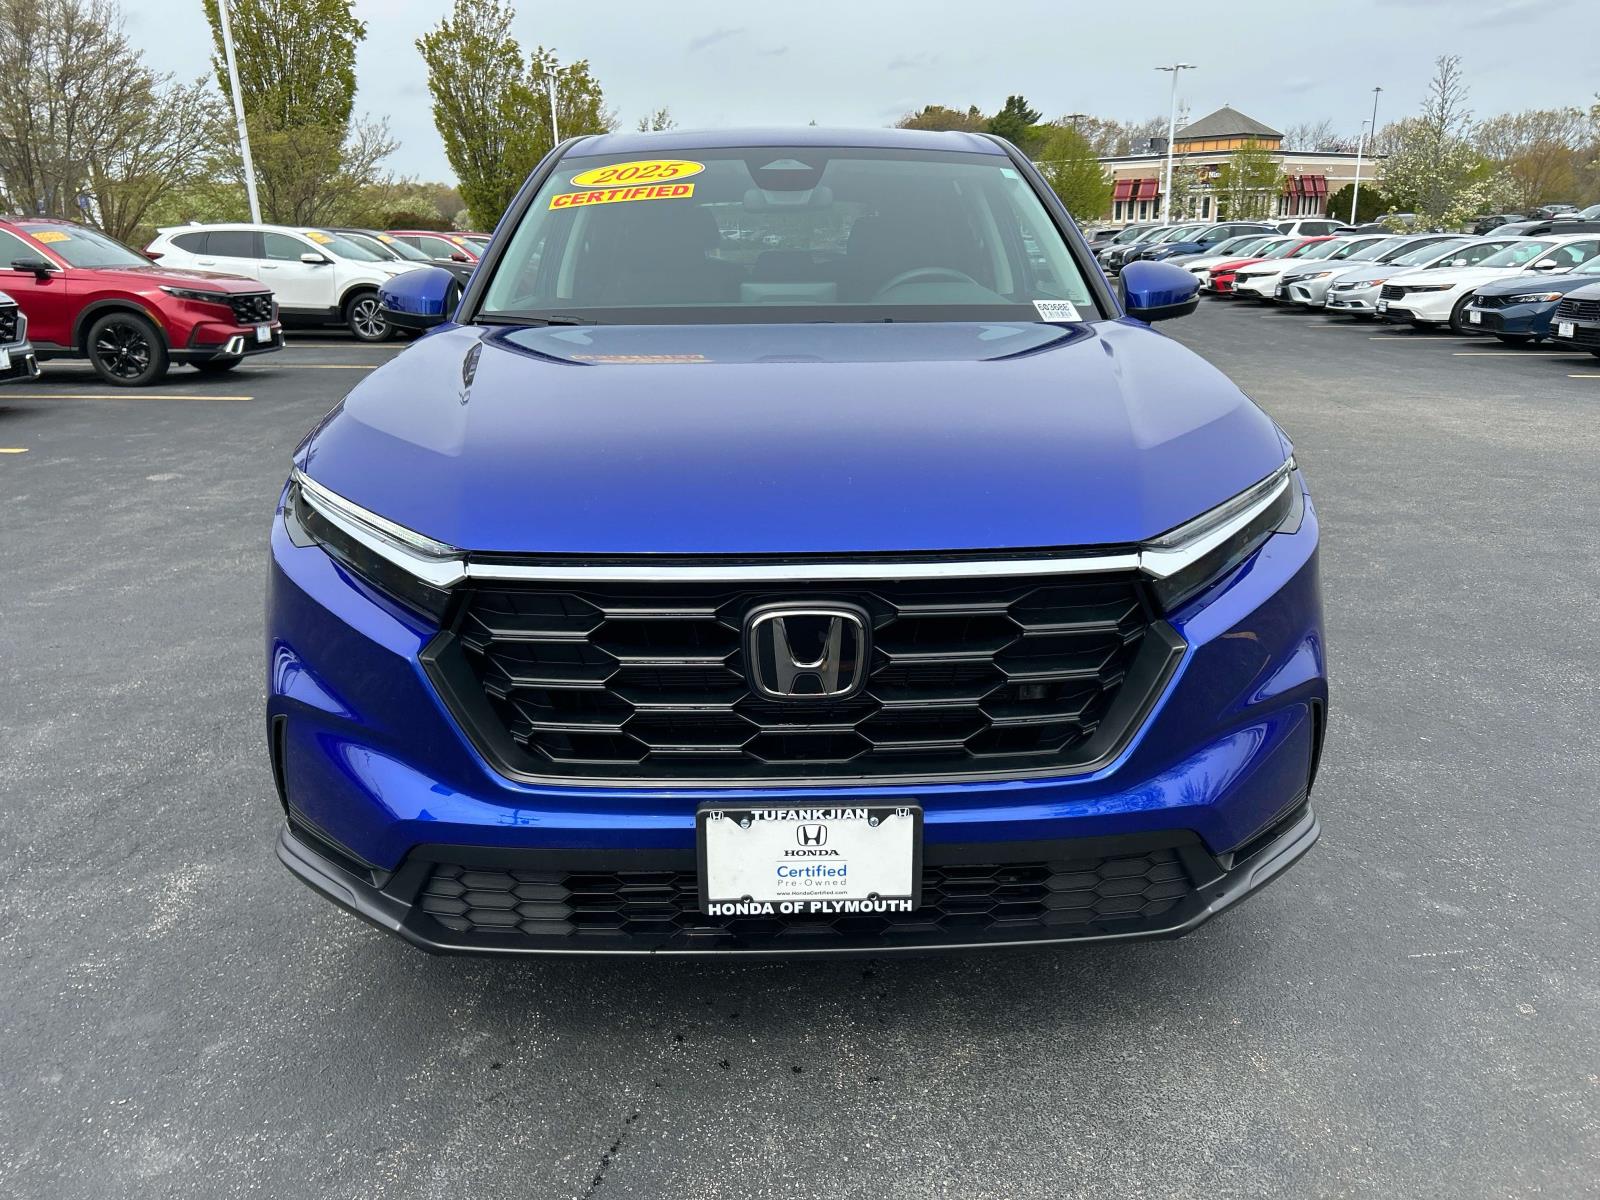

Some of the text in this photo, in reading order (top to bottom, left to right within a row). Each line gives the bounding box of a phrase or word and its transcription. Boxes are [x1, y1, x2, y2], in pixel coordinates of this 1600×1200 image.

[592, 163, 684, 184] 2025
[553, 185, 690, 207] CERTIFIED
[751, 808, 868, 821] TUFANKJIAN
[784, 849, 840, 857] HONDA
[776, 864, 847, 878] Certified
[777, 878, 847, 887] Pre-Owned
[708, 899, 913, 916] HONDA OF PLYMOUTH
